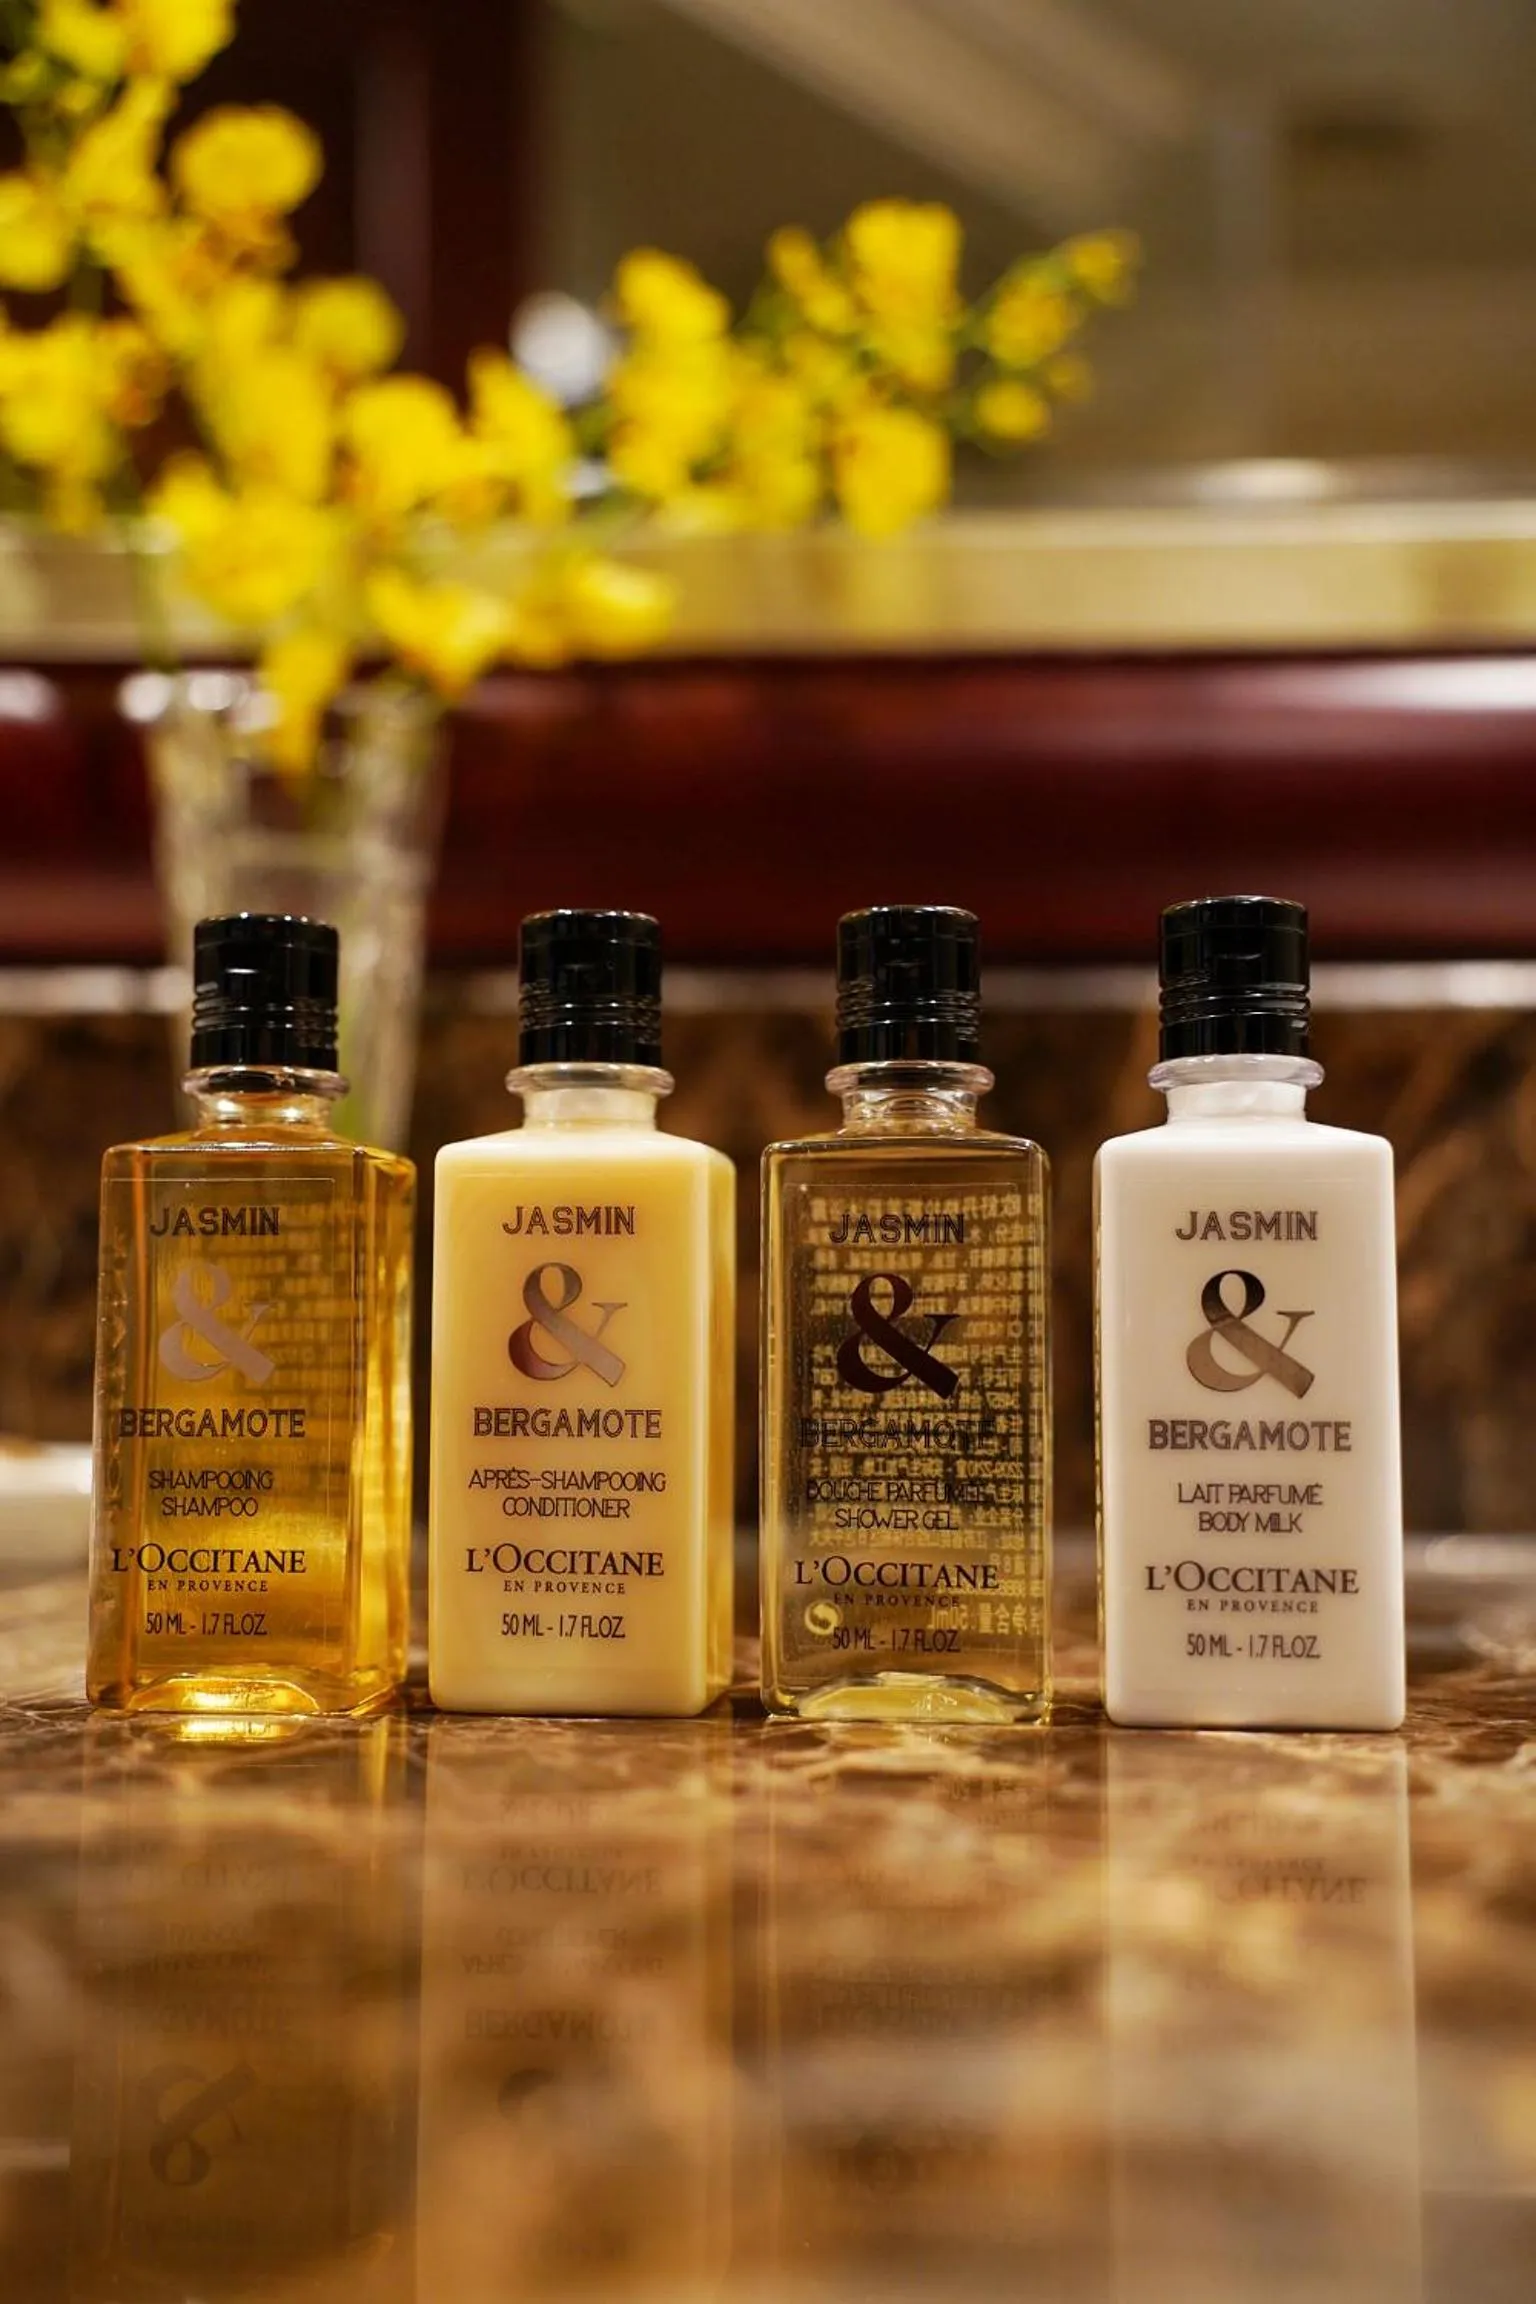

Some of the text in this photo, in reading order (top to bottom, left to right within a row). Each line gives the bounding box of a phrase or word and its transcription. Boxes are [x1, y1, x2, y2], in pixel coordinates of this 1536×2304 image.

[150, 1206, 280, 1237] JASMIN
[502, 1205, 636, 1236] JASMIN
[829, 1213, 965, 1244] JASMIN
[1175, 1210, 1318, 1241] JASMIN
[158, 1263, 277, 1384] &
[508, 1262, 629, 1388] &
[837, 1272, 961, 1400] &
[1186, 1269, 1316, 1400] &
[118, 1408, 306, 1438] BERGAMOTE
[473, 1407, 662, 1439] BERGAMOTE
[800, 1417, 995, 1449] BERGAMOTE
[1148, 1419, 1352, 1452] BERGAMOTE
[149, 1469, 274, 1491] SHAMPOOING
[806, 1479, 882, 1502] DOUCHE
[1178, 1481, 1323, 1506] LAIT PARFUMÉ
[160, 1496, 259, 1517] SHAMPOO
[502, 1496, 631, 1519] CONDITIONER
[834, 1507, 919, 1530] SHOWER
[922, 1509, 959, 1531] GEL
[1198, 1510, 1303, 1533] BODY MILK
[111, 1542, 307, 1574] L'OCCITANE
[465, 1542, 665, 1577] L'OCCITANE
[794, 1555, 1000, 1590] L'OCCITANE
[147, 1579, 269, 1593] EN PROVENCE
[503, 1579, 627, 1595] EN PROVENCE
[1144, 1559, 1360, 1595] L'OCCITANE
[833, 1592, 961, 1609] EN PROVENCE
[1186, 1598, 1319, 1614] EN PROVENCE
[145, 1612, 163, 1635] 50
[166, 1612, 187, 1636] ML
[202, 1612, 221, 1636] 1.7
[501, 1613, 520, 1637] 50
[522, 1613, 545, 1638] ML
[559, 1614, 578, 1638] 1.7
[832, 1626, 851, 1650] 50
[853, 1626, 876, 1651] ML
[1186, 1633, 1206, 1657] 50
[1209, 1633, 1233, 1658] ML
